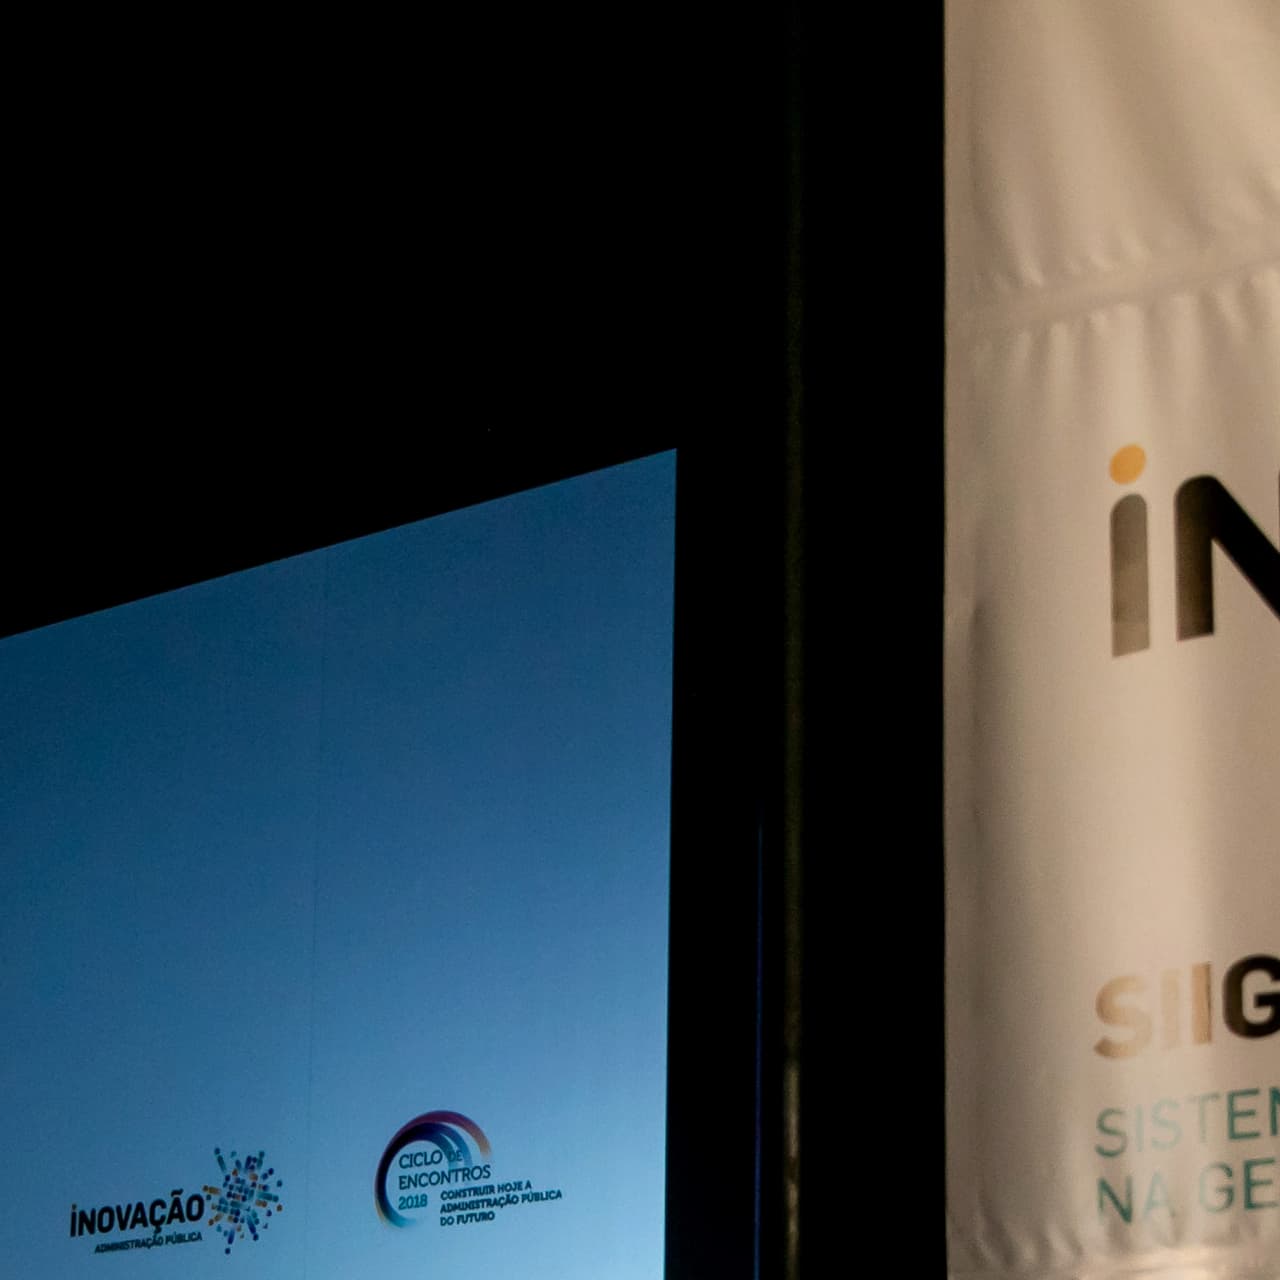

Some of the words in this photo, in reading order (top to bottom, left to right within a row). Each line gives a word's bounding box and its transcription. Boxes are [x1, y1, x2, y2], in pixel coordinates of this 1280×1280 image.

[399, 1150, 443, 1169] CICLO
[450, 1150, 464, 1163] DE
[399, 1164, 491, 1190] ENCONTROS
[440, 1184, 496, 1201] CONSTRUIR
[497, 1181, 523, 1194] HOJE
[525, 1179, 533, 1190] A
[440, 1194, 519, 1213] ADMINISTRAÇÃO
[521, 1189, 563, 1204] PÚBLICA
[1095, 1170, 1172, 1226] NA
[399, 1194, 428, 1210] 2018
[440, 1216, 455, 1227] DO
[457, 1211, 496, 1225] FUTURO
[94, 1233, 164, 1254] ADMINISTRAÇÃO
[165, 1231, 203, 1246] PÚBLICA
